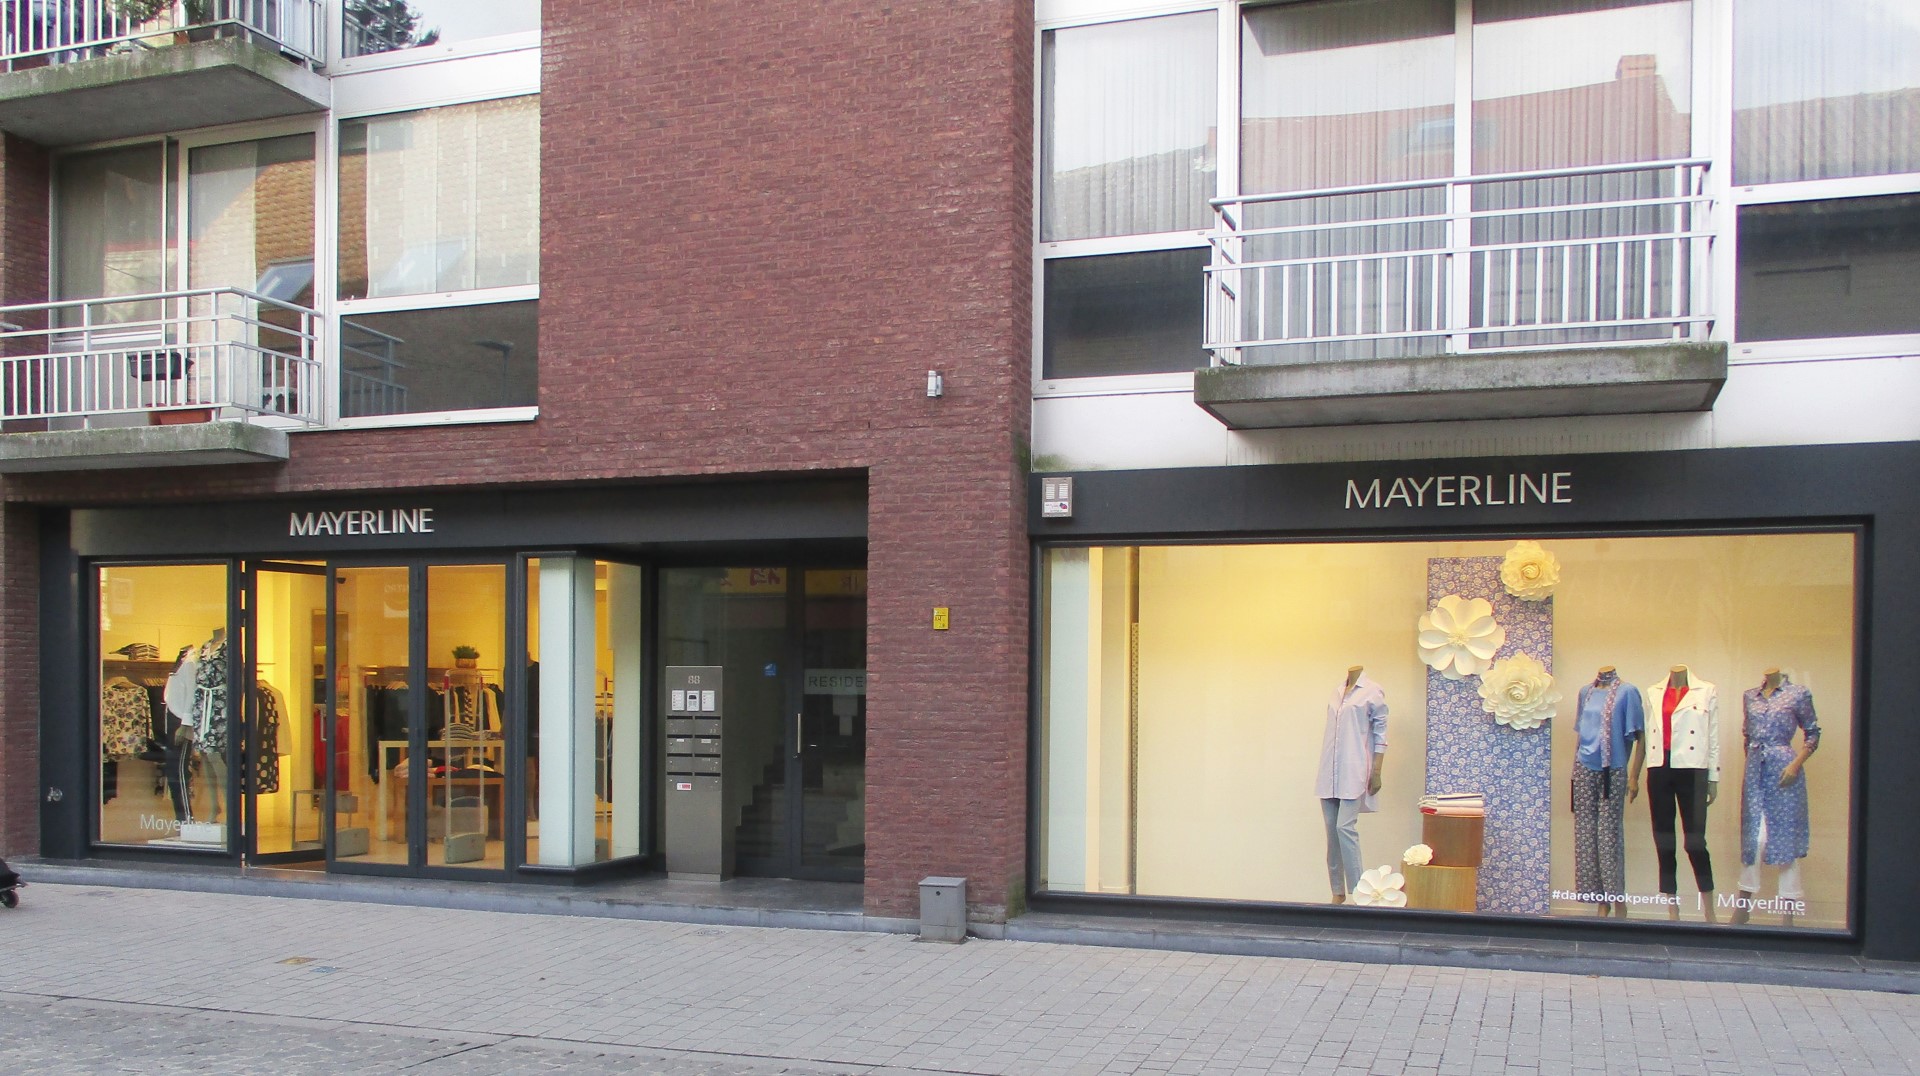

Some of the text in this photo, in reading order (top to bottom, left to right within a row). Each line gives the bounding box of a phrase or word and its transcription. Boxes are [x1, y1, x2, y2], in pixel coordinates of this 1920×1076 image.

[1344, 471, 1572, 509] MAYERLINE
[289, 508, 435, 536] MAYERLINE
[140, 813, 212, 836] Mayerline
[1551, 889, 1682, 906] #daretolookperfect
[1717, 893, 1806, 912] Mayerline
